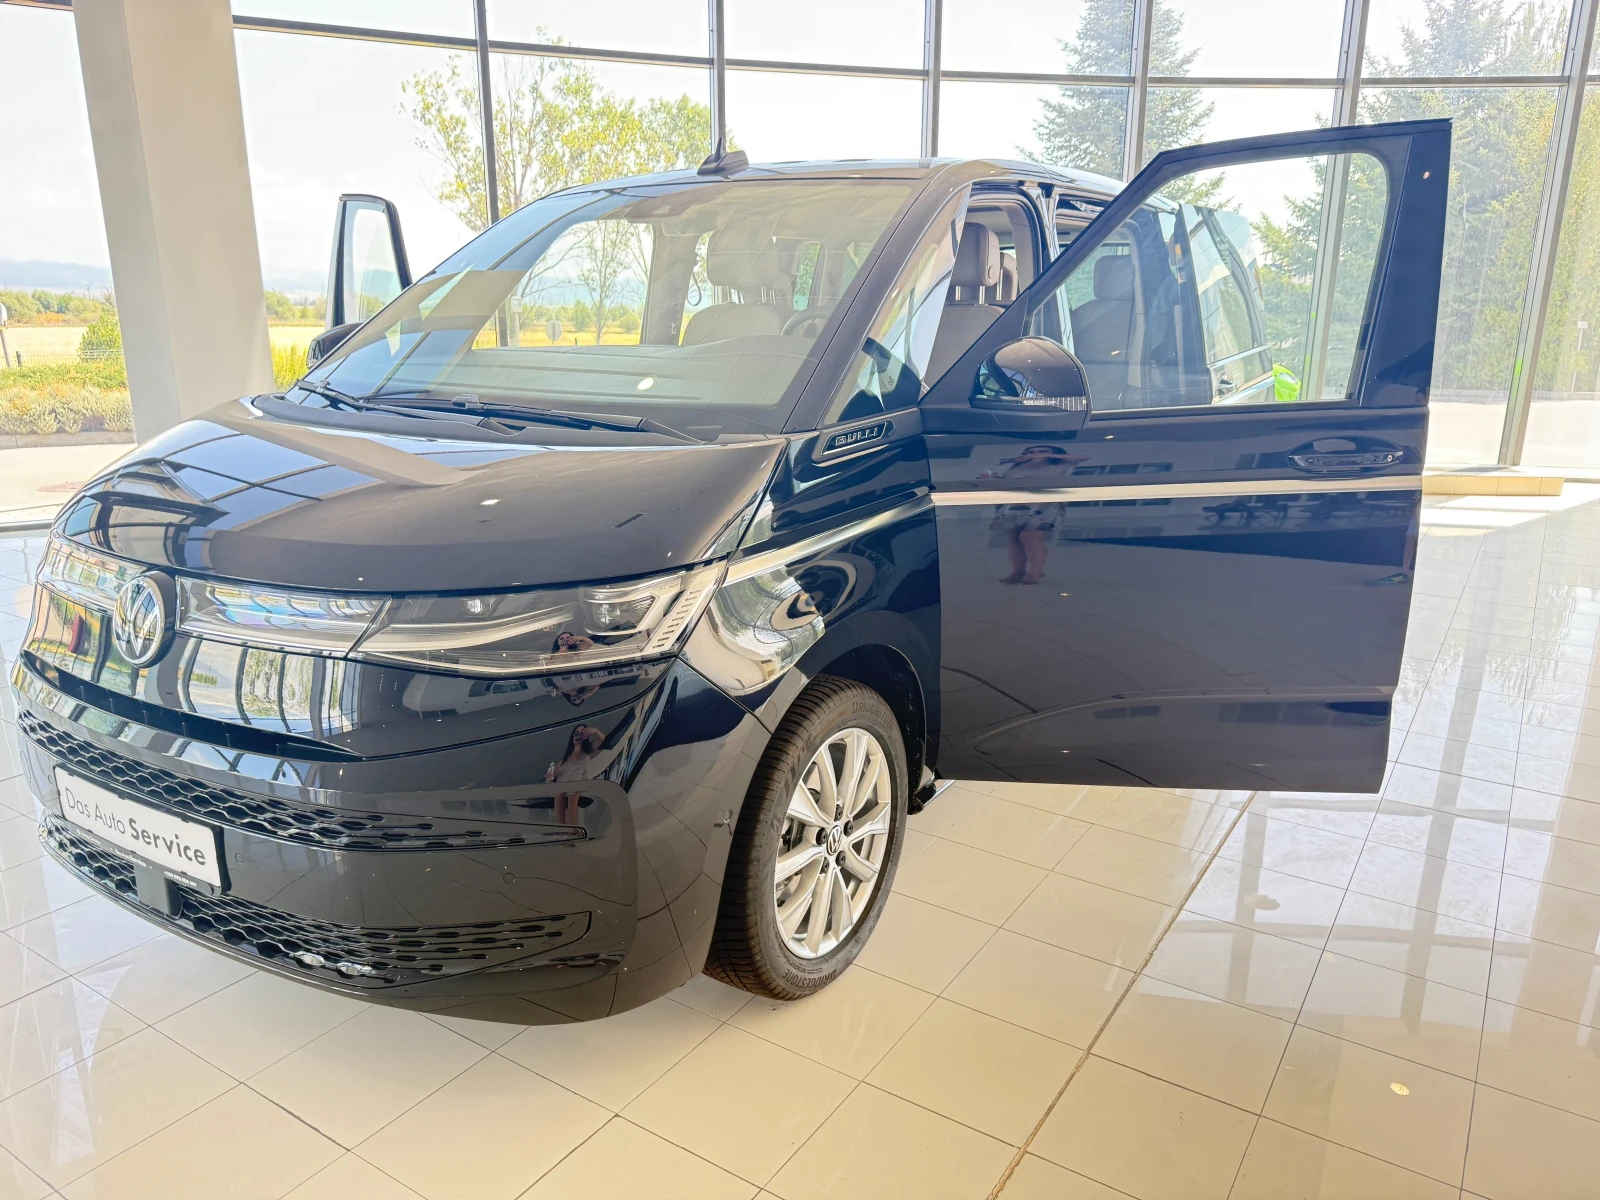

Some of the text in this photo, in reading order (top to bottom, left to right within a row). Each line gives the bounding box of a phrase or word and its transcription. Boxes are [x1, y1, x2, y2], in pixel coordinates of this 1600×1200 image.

[835, 427, 879, 446] BULLI
[852, 701, 894, 731] BRIDGESTONE
[64, 786, 91, 818] Das
[94, 802, 126, 835] Auto
[128, 817, 206, 866] Service
[781, 967, 838, 988] BRIDGESTONE
